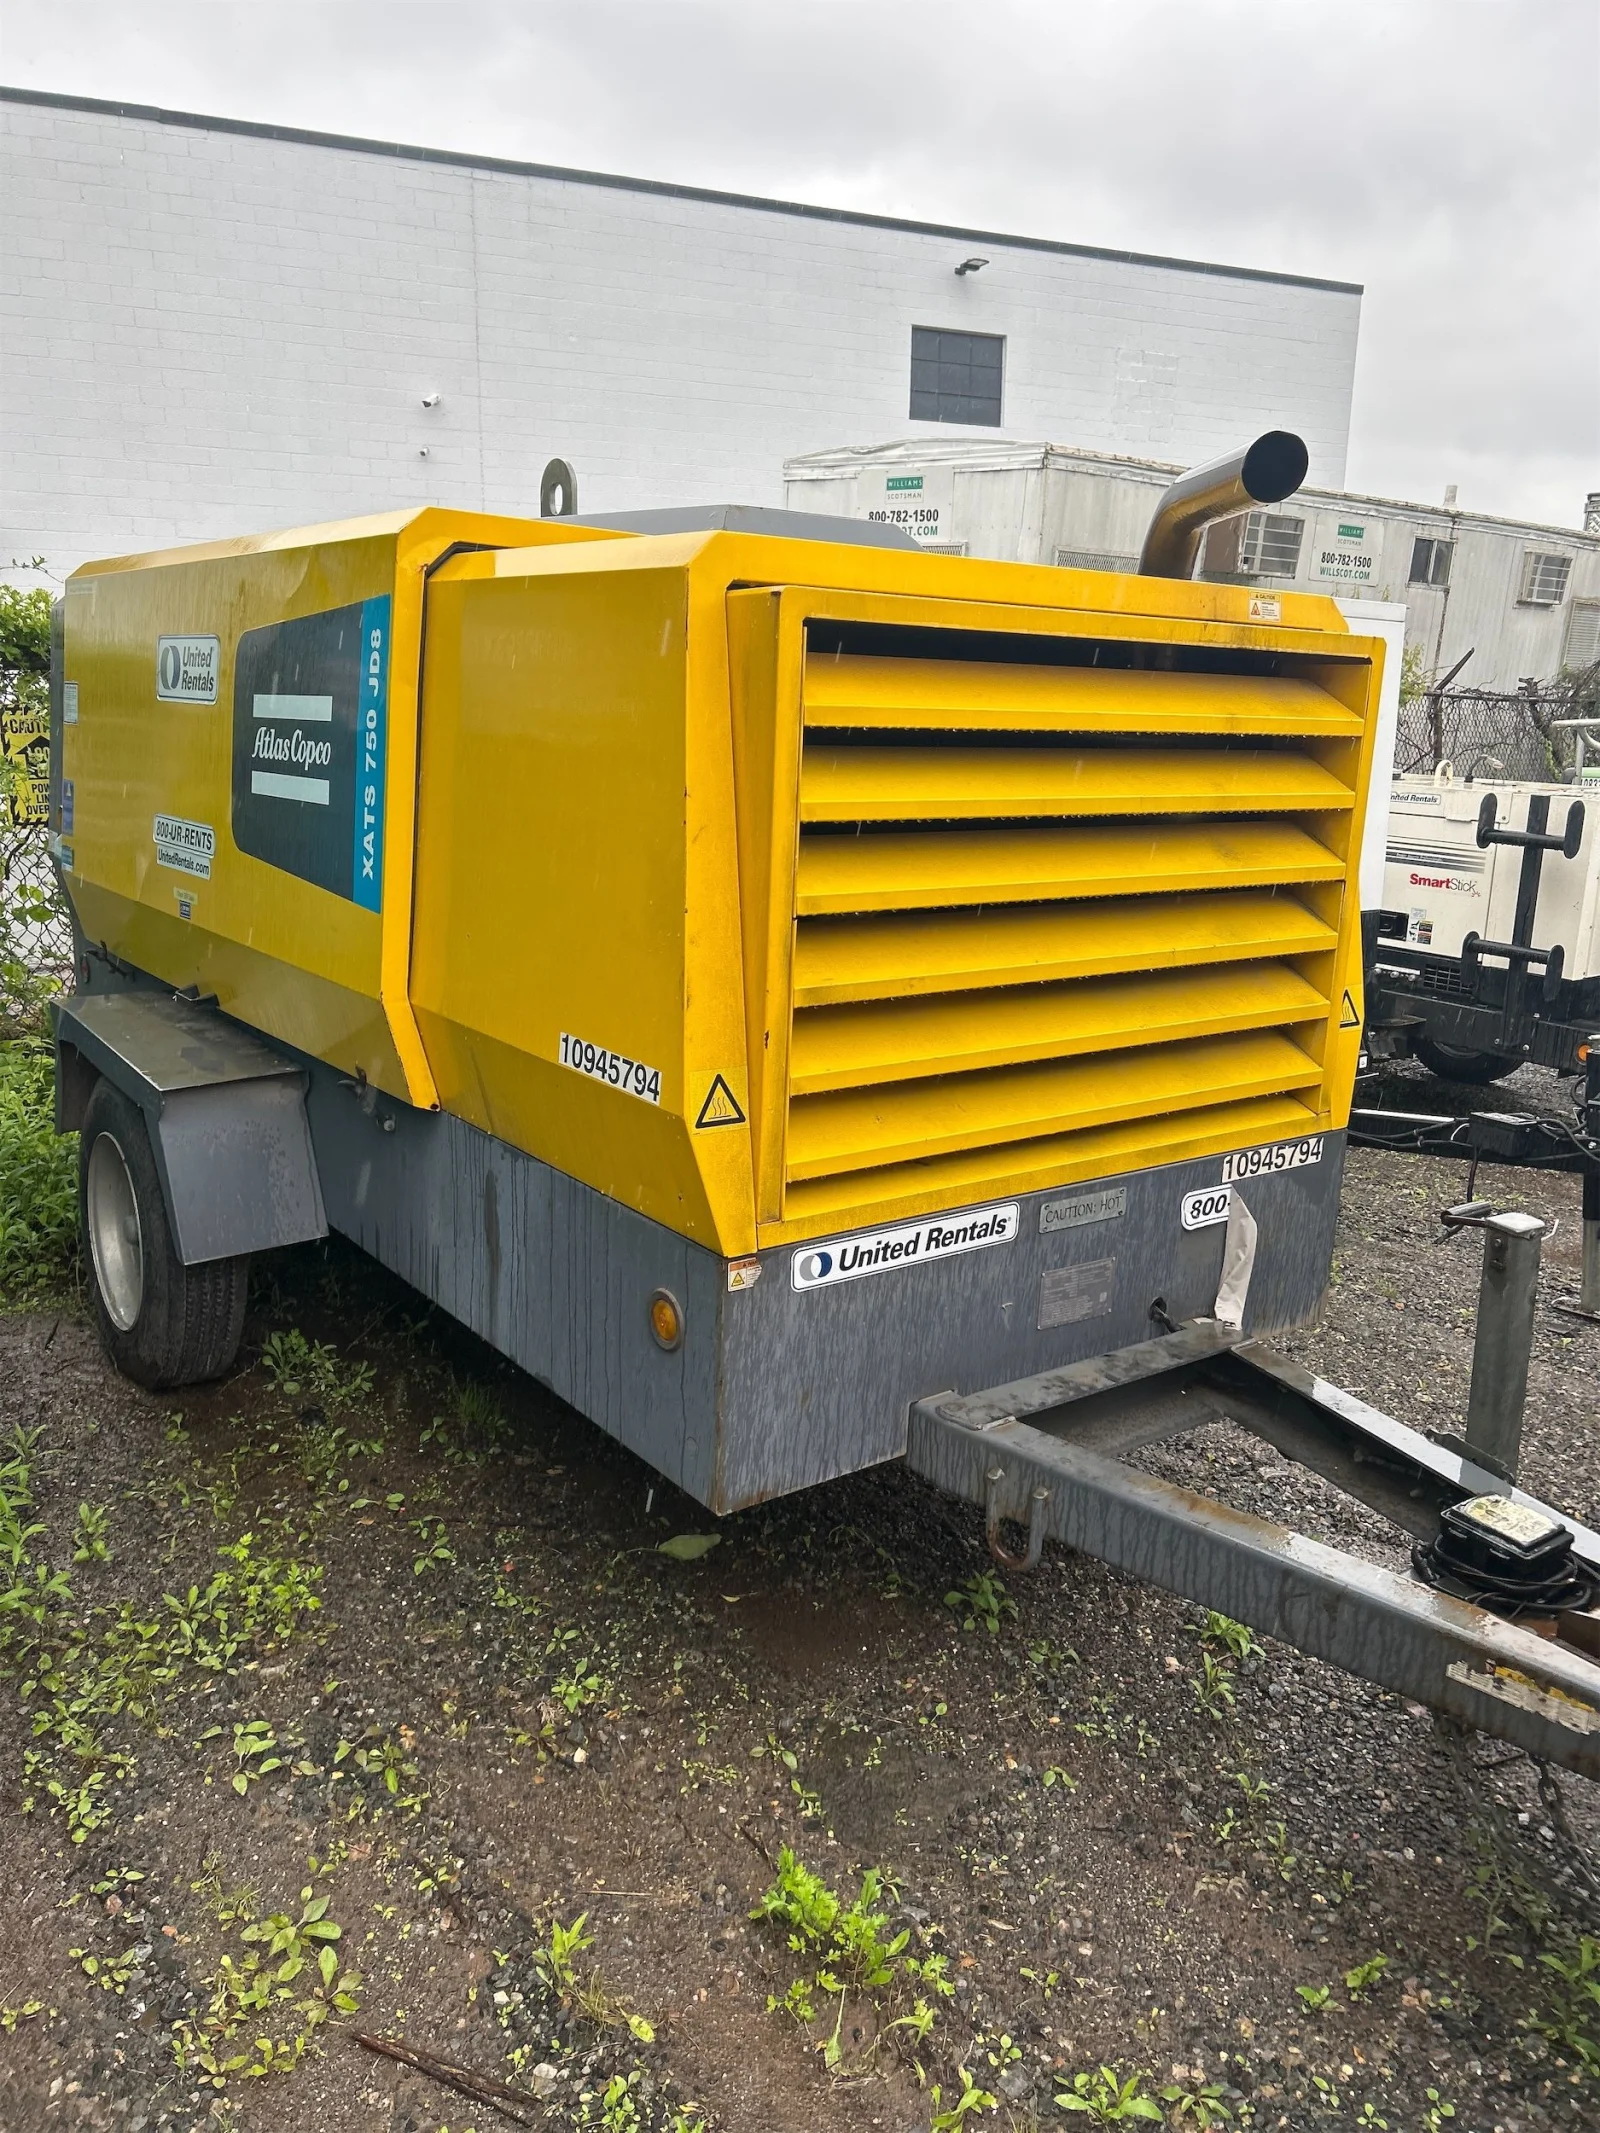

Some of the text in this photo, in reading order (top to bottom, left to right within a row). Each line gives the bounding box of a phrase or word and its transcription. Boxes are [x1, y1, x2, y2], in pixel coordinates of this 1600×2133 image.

[888, 479, 922, 488] WILLIAMS
[887, 492, 922, 500] SCOTSMAN
[868, 508, 939, 523] 800-782-1500
[1320, 551, 1372, 569] 800-782-1500
[1319, 566, 1370, 580] WILLSCOT.COM
[182, 646, 212, 668] United
[181, 669, 214, 692] Rentals
[362, 628, 382, 881] XATS 750 JD8
[1410, 794, 1437, 803] Rentals
[156, 820, 213, 851] 800-UR-RENTS
[158, 847, 210, 876] UnitedRentals.com
[1409, 873, 1476, 892] SmartStick
[561, 1033, 661, 1102] 10945794
[1225, 1137, 1322, 1180] 10945794
[1045, 1195, 1123, 1224] CAUTION: HOT
[838, 1213, 1009, 1272] United Rentals
